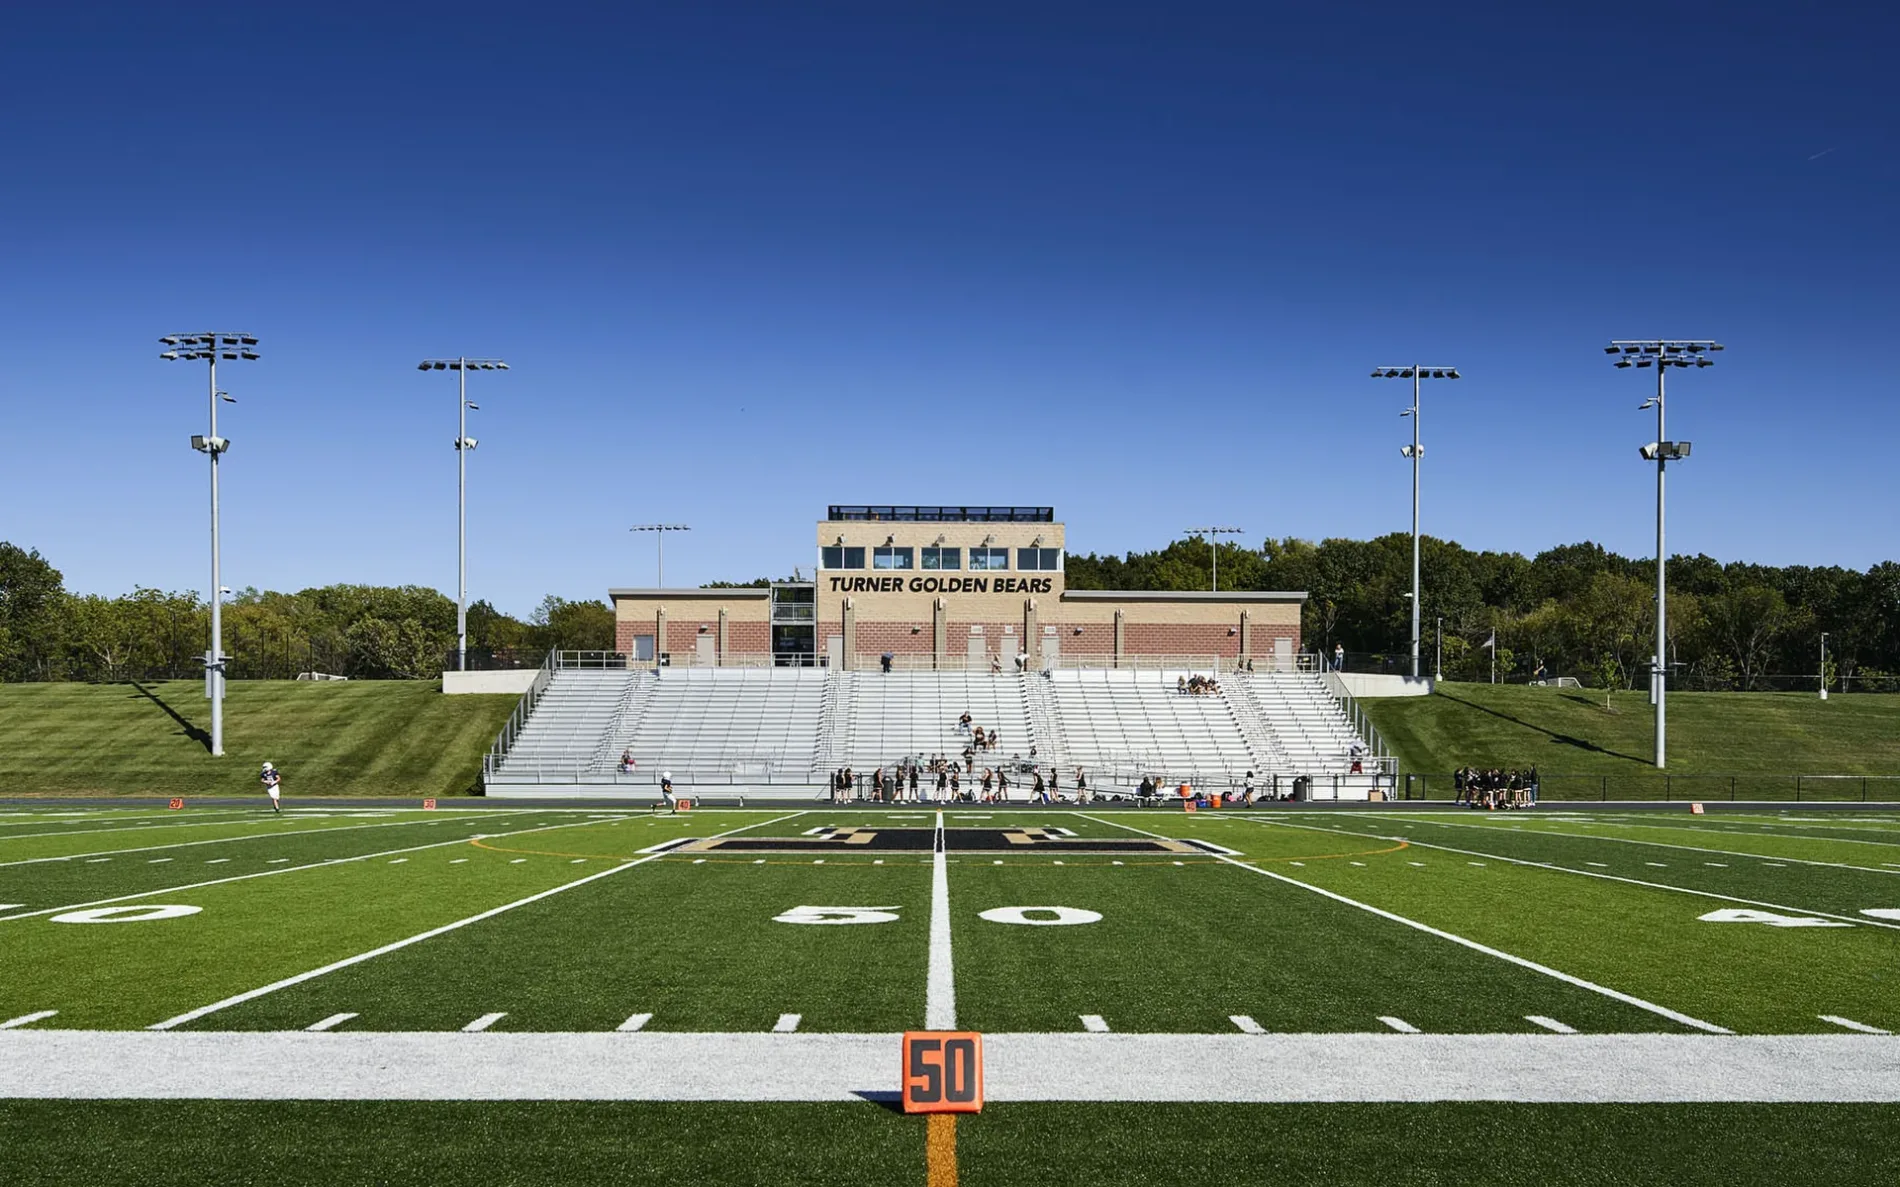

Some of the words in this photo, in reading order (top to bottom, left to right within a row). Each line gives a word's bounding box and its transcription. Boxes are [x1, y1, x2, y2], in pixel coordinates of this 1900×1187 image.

[829, 577, 904, 592] TURNER
[908, 577, 988, 593] GOLDEN
[992, 578, 1052, 593] BEARS
[771, 906, 1103, 925] 50
[910, 1039, 975, 1103] 50
